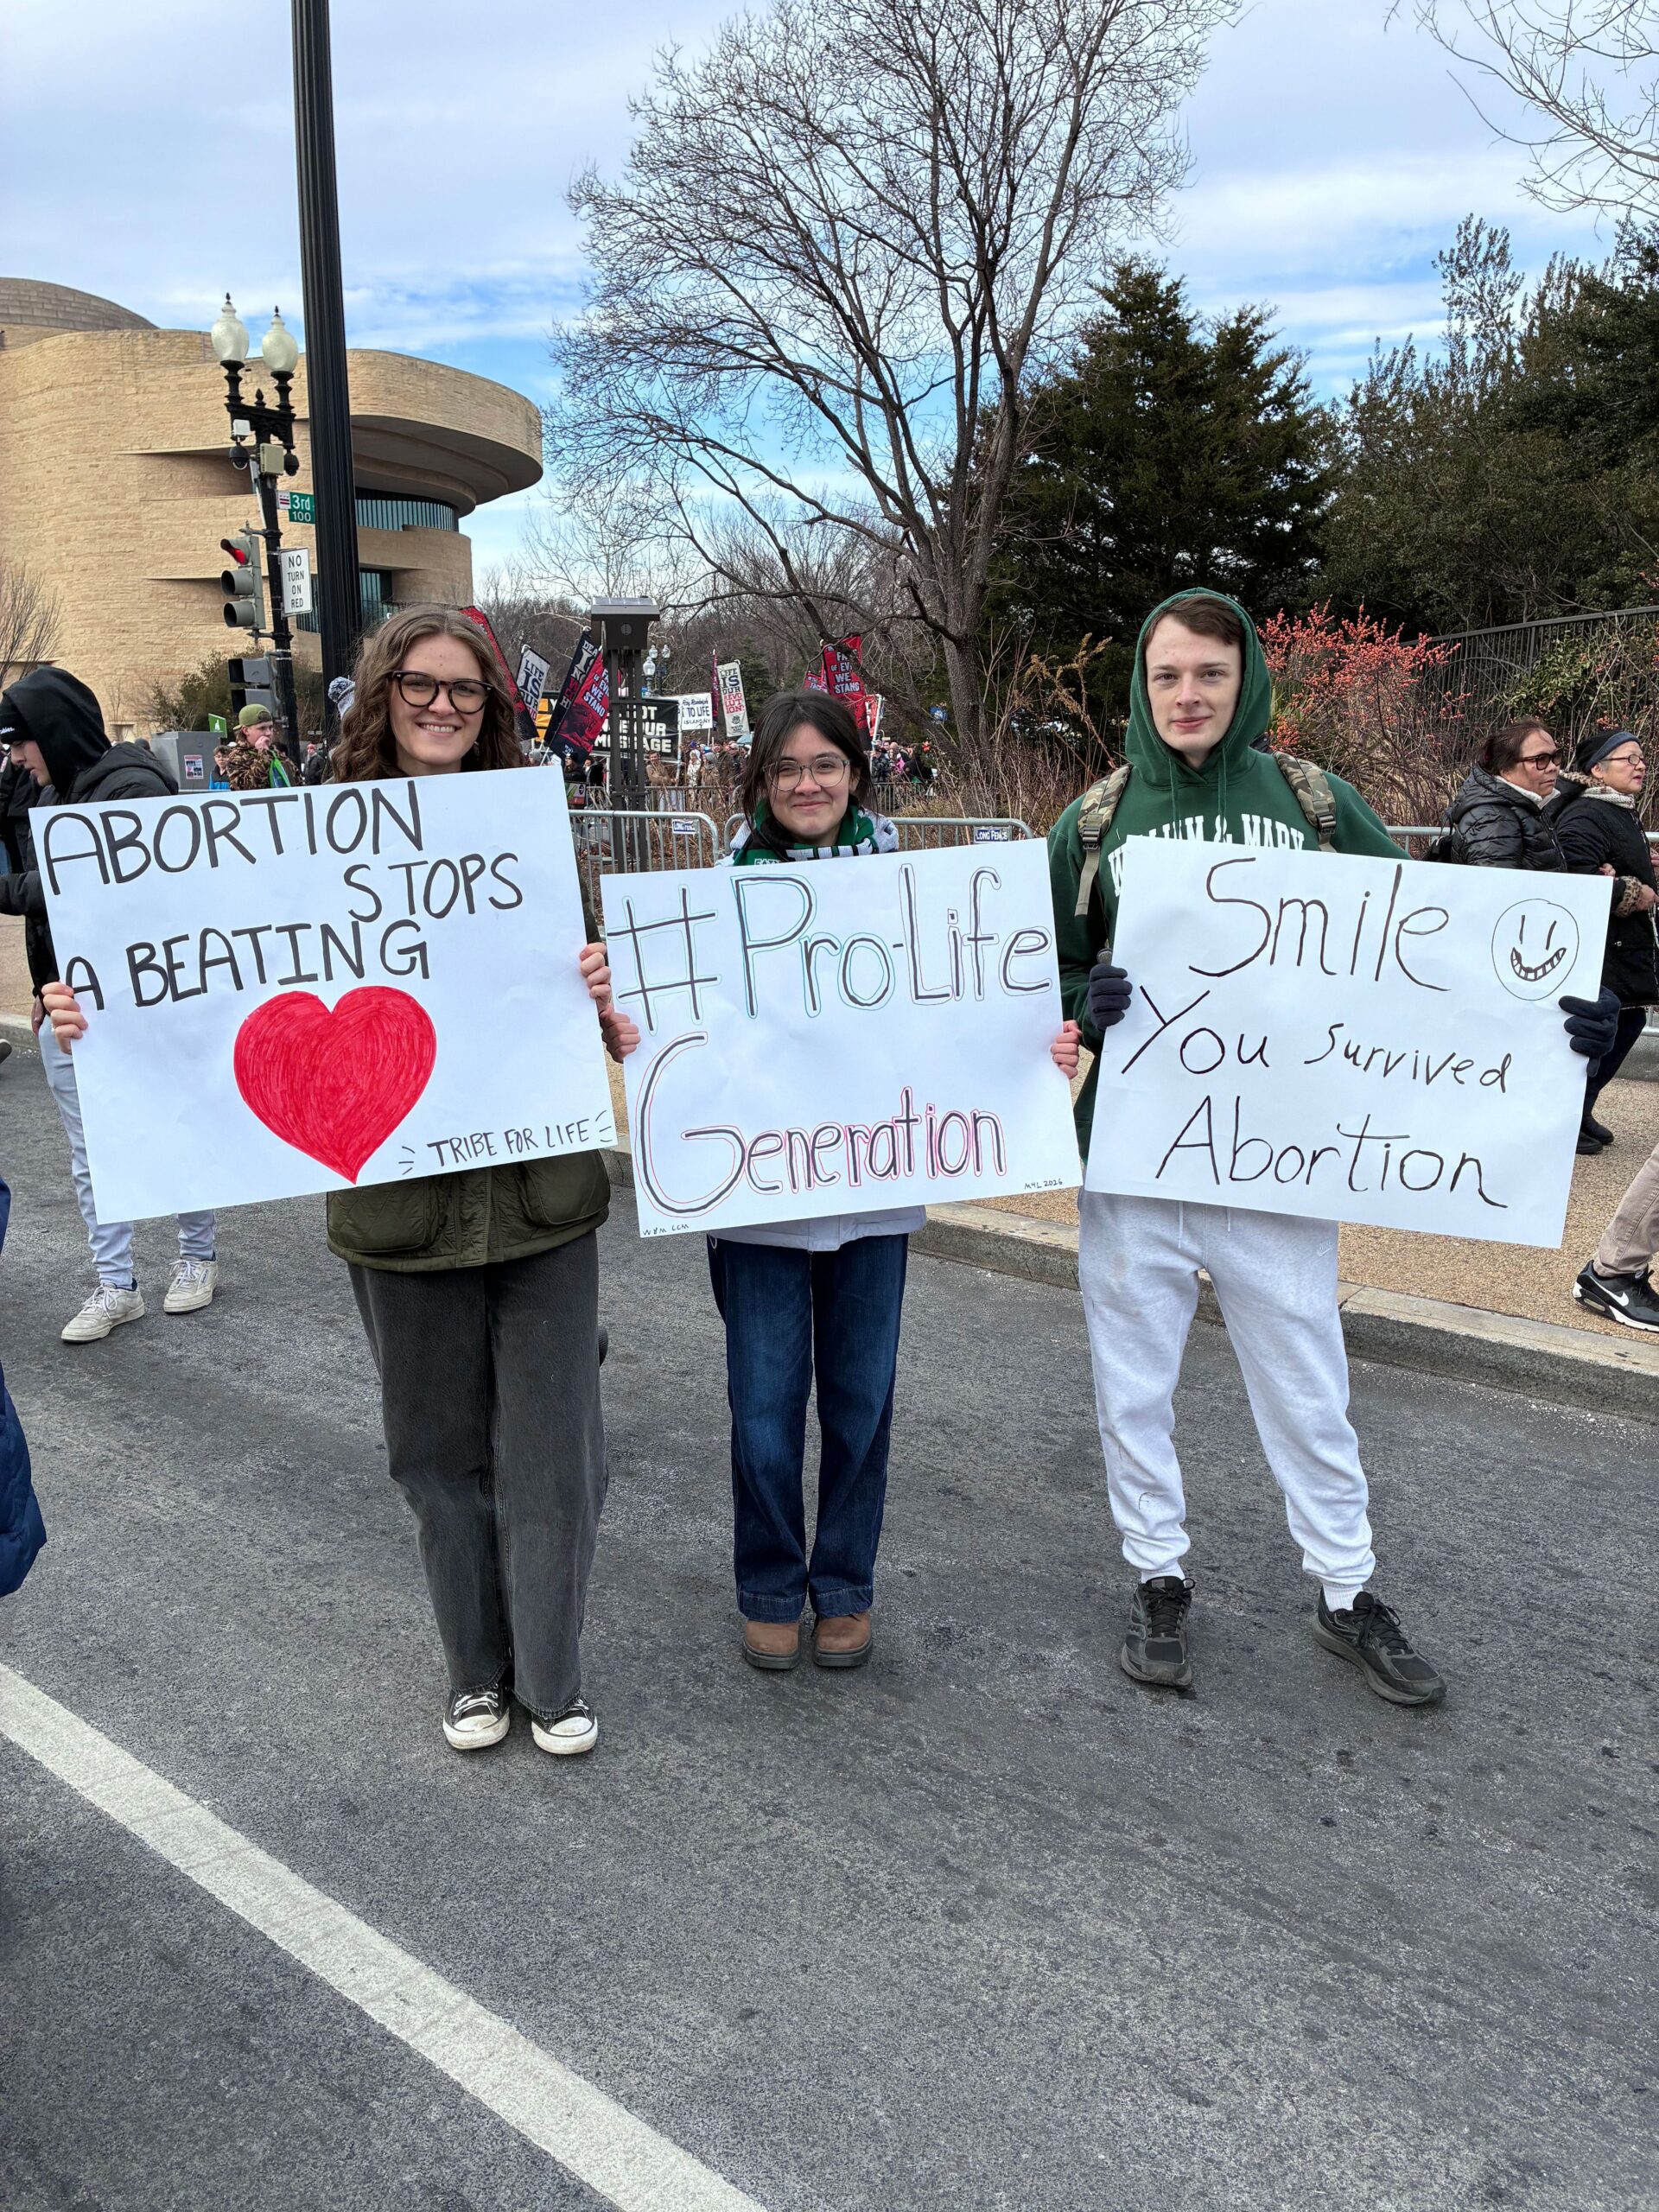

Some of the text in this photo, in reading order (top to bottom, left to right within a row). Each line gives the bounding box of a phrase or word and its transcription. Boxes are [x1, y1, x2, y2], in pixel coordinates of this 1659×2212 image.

[292, 494, 310, 511] 3rd
[292, 511, 311, 522] 100
[288, 555, 302, 569] NO
[287, 570, 304, 582] TURN
[291, 584, 302, 595] ON
[290, 598, 304, 608] RED
[524, 659, 544, 682] LIFE
[720, 668, 738, 677] LIFE
[835, 673, 851, 683] WE
[518, 671, 543, 700] IS
[721, 675, 740, 689] IS
[835, 682, 860, 694] STAND
[591, 683, 603, 702] WE
[583, 691, 606, 717] STAND
[687, 707, 696, 717] TO
[696, 705, 710, 717] LIFE
[43, 780, 423, 896] ABORTION
[976, 830, 990, 841] LONG
[343, 852, 524, 923] STOPS
[1188, 857, 1452, 993] Smile
[606, 864, 1052, 1037] #Pro-Life
[65, 918, 430, 1011] A BEATING
[1121, 985, 1270, 1075] You
[634, 1031, 1007, 1219] Generation
[426, 1118, 590, 1167] TRIBE FOR LIFE
[1154, 1095, 1509, 1210] Abortion
[1043, 1178, 1064, 1187] 2026
